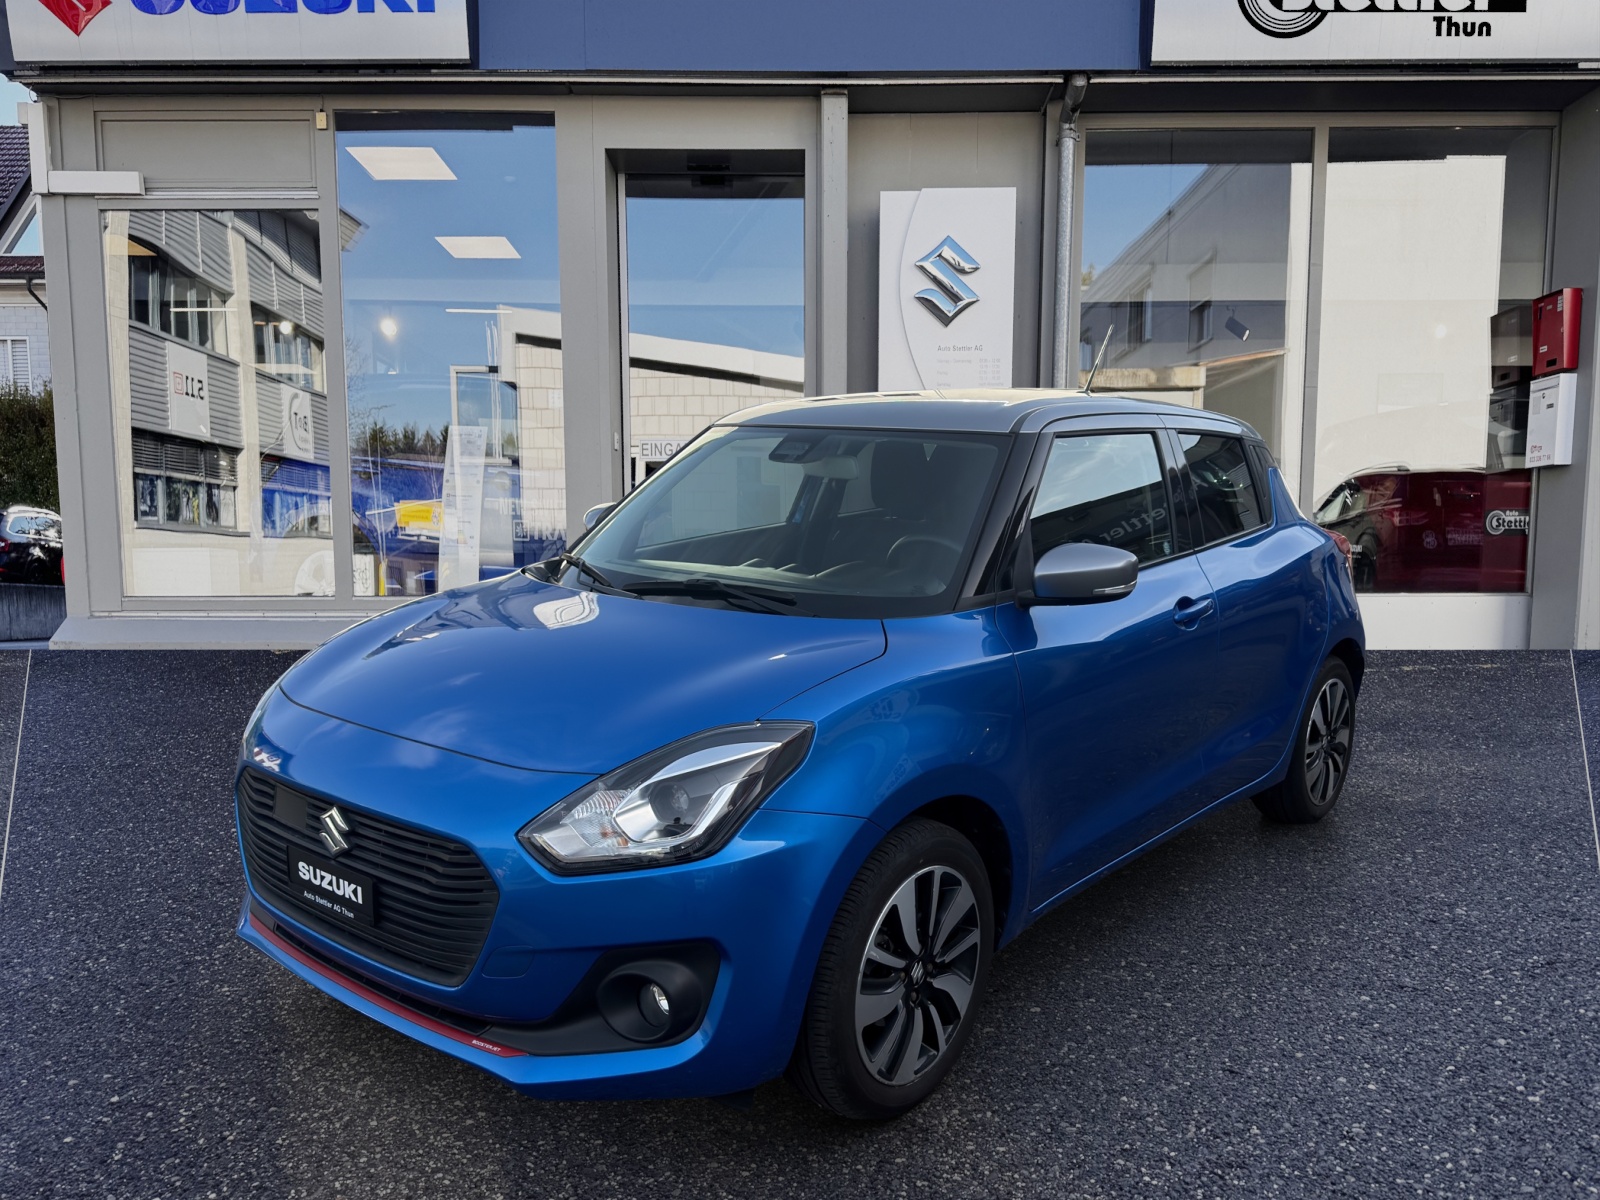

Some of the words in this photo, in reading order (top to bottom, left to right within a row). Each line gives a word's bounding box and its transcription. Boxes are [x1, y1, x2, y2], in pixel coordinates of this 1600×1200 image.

[1433, 16, 1492, 37] Thun
[298, 861, 363, 904] SUZUKI
[303, 890, 315, 901] Auto
[315, 895, 333, 909] Stettler
[333, 903, 341, 913] AG
[341, 907, 355, 919] Thun
